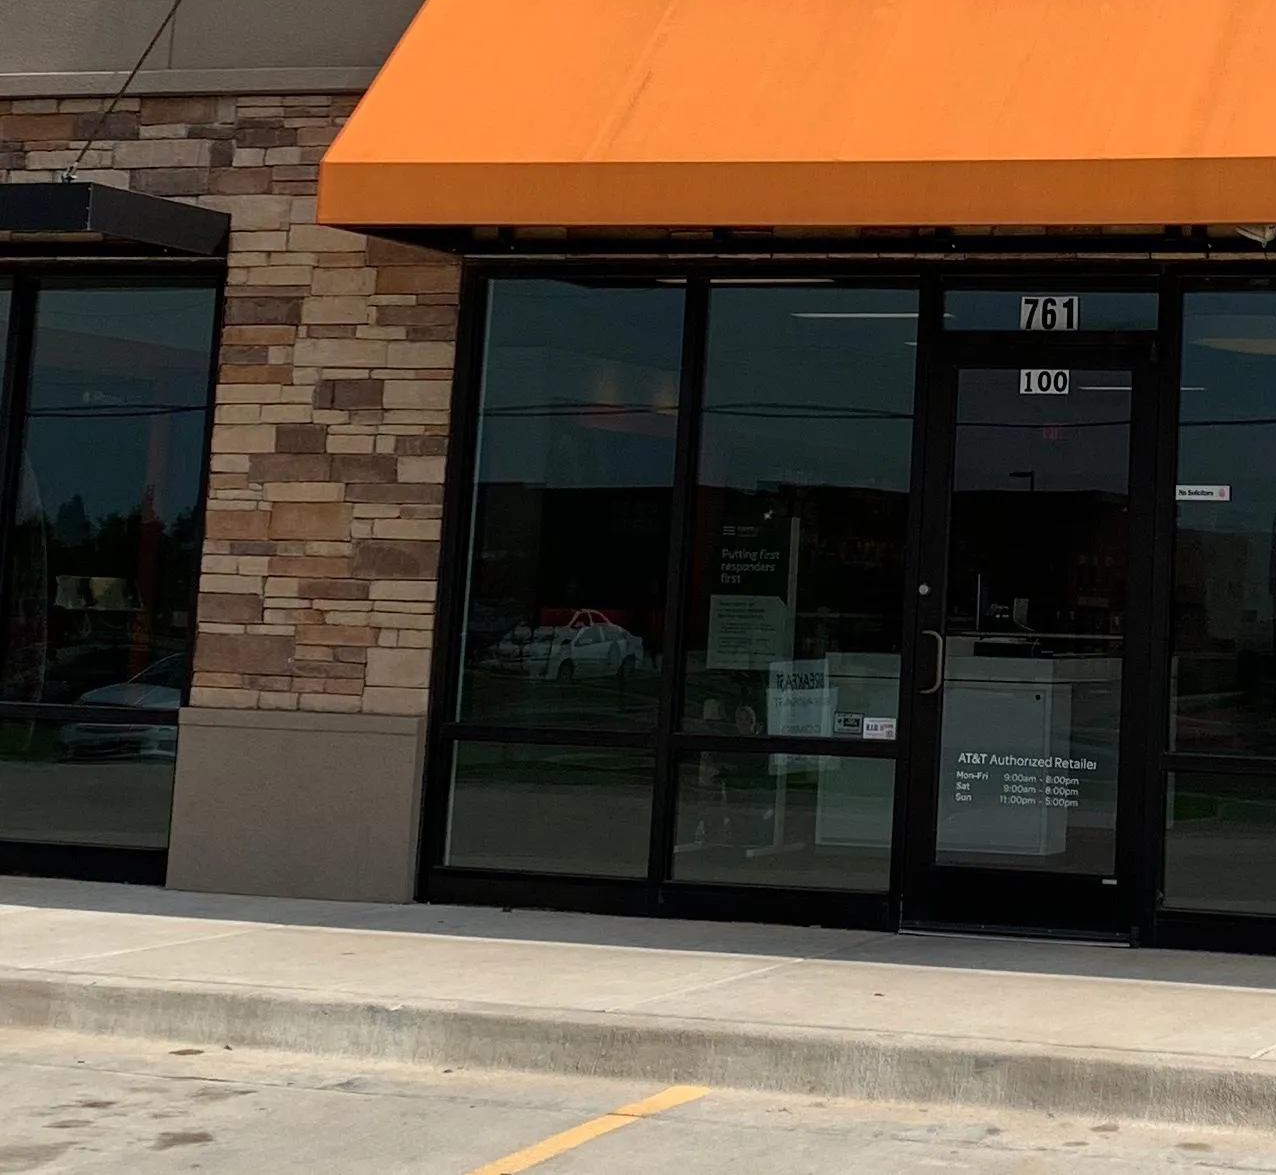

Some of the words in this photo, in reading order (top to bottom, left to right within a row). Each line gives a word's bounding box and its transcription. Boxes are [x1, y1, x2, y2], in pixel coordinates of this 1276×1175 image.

[1023, 297, 1074, 330] 761
[1023, 370, 1068, 393] 100
[1187, 489, 1214, 497] Solicitors
[721, 547, 758, 562] Putting
[759, 548, 780, 560] first
[720, 561, 776, 574] responders
[720, 572, 741, 584] first
[957, 752, 988, 765] AT&T
[988, 753, 1053, 769] Authorized
[1054, 756, 1098, 770] Retailer
[955, 770, 989, 781] Mon-Fri
[1003, 772, 1037, 783] 9:00am
[1045, 775, 1080, 786] 8:00pm
[955, 781, 971, 791] Sat
[1002, 784, 1037, 794] 9:00am
[1044, 786, 1079, 797] 8:00pm
[955, 792, 972, 802] Sun
[1044, 796, 1079, 807] 5:00pm
